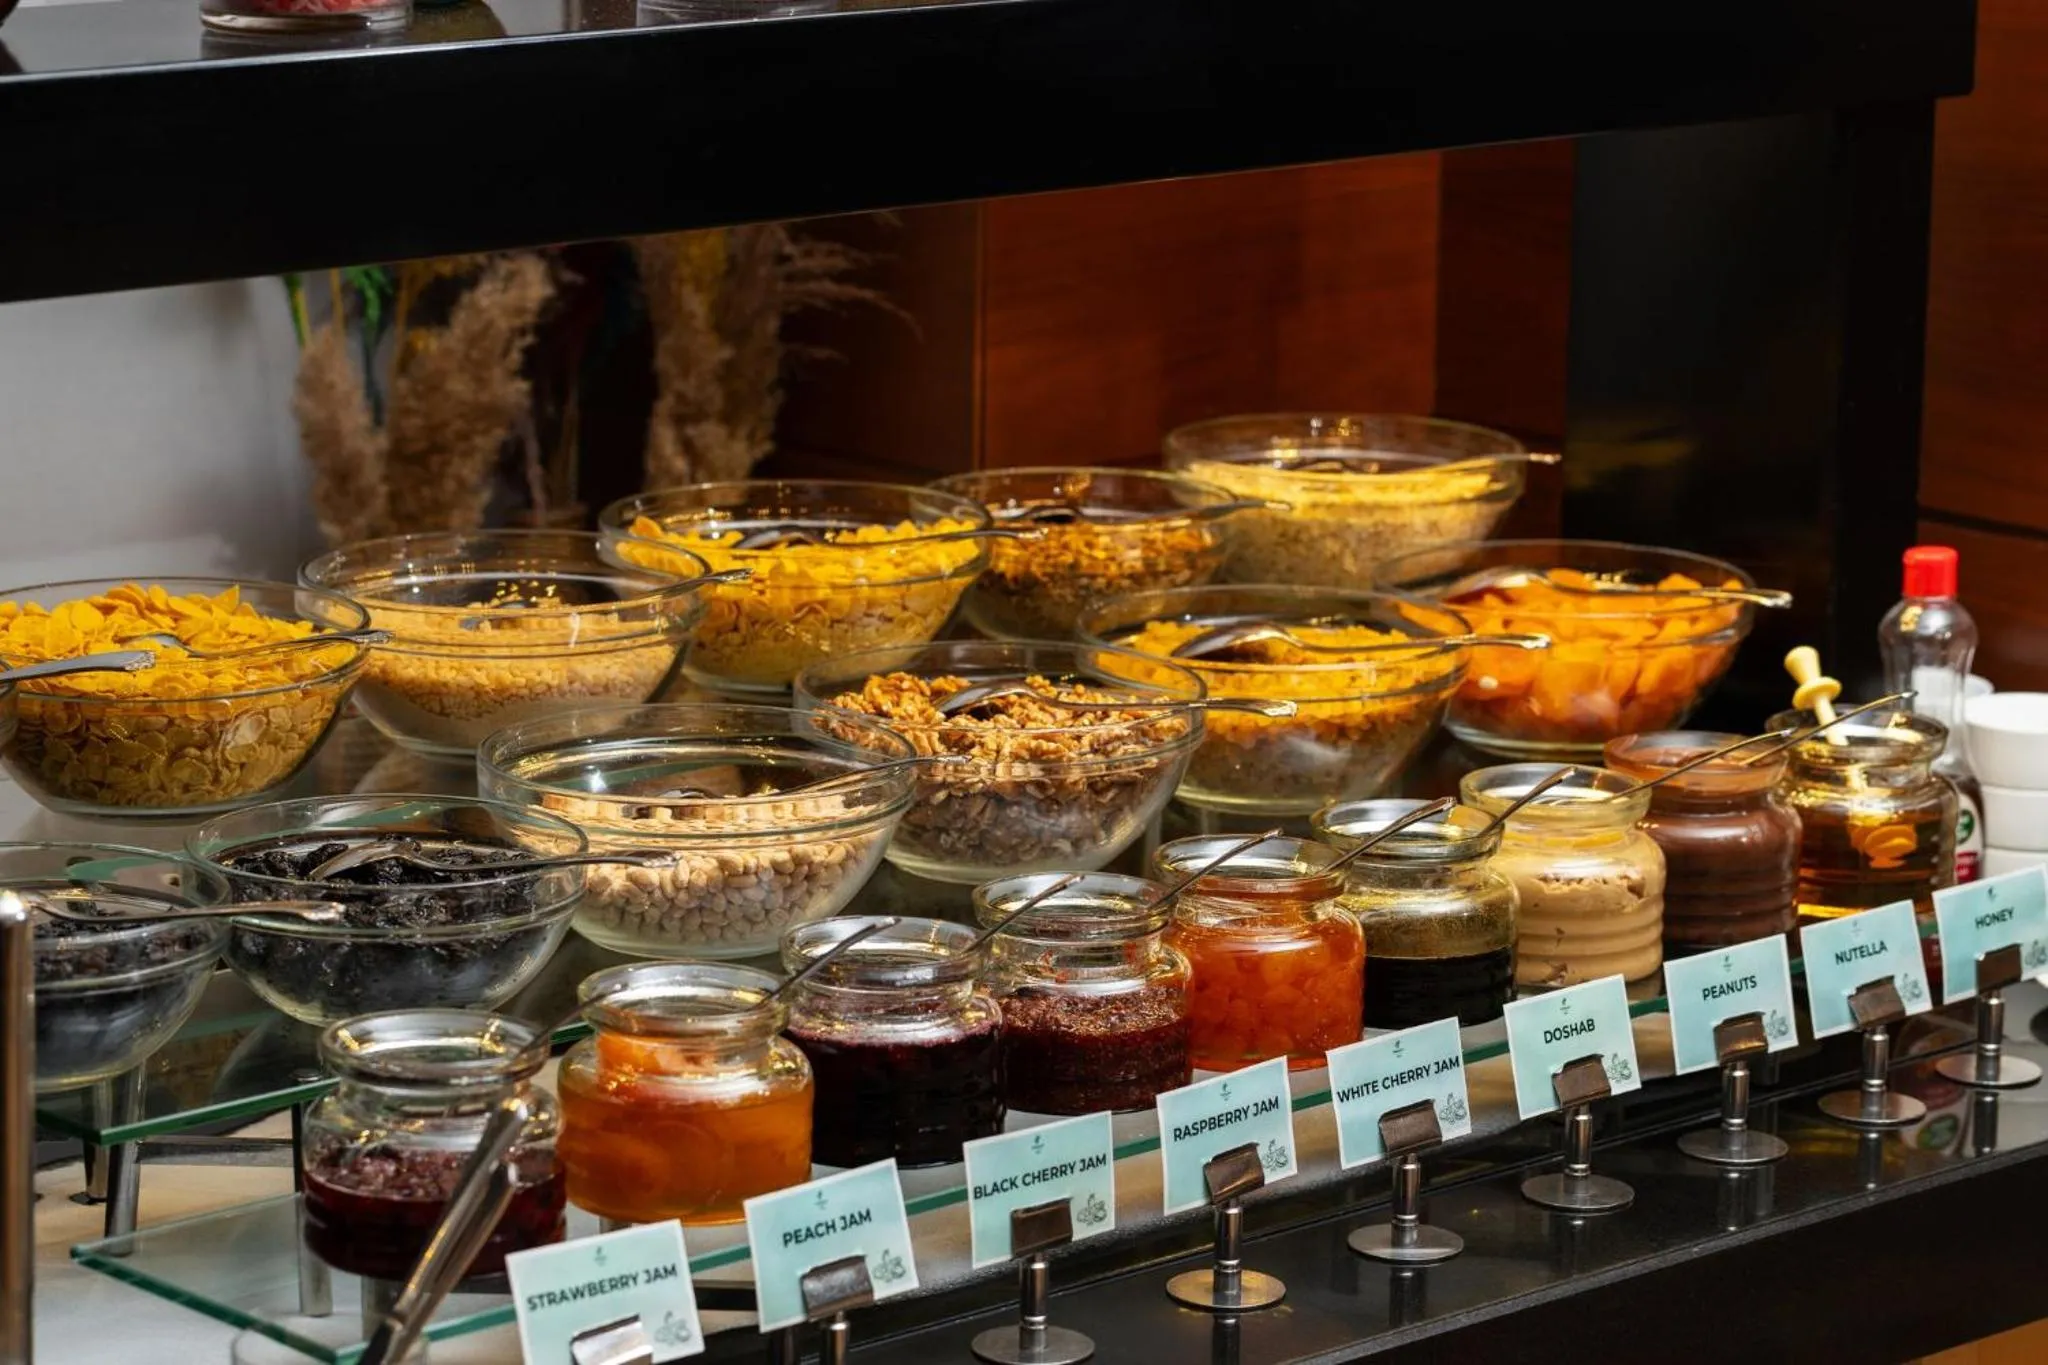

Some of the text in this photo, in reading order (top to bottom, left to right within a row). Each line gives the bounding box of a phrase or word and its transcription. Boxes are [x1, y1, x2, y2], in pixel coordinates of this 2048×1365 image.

[1975, 907, 2014, 929] HONEY
[1835, 940, 1888, 965] NUTELLA
[1702, 975, 1757, 1001] PEANUTS
[1543, 1018, 1596, 1044] DOSHAB
[1337, 1056, 1460, 1103] WHITE CHERRY JAM
[1173, 1096, 1279, 1142] RASPBERRY JAM
[973, 1153, 1107, 1200] BLACK CHERRY JAM
[783, 1208, 872, 1248] PEACH JAM
[527, 1263, 678, 1311] STRAWBERRY JAM
